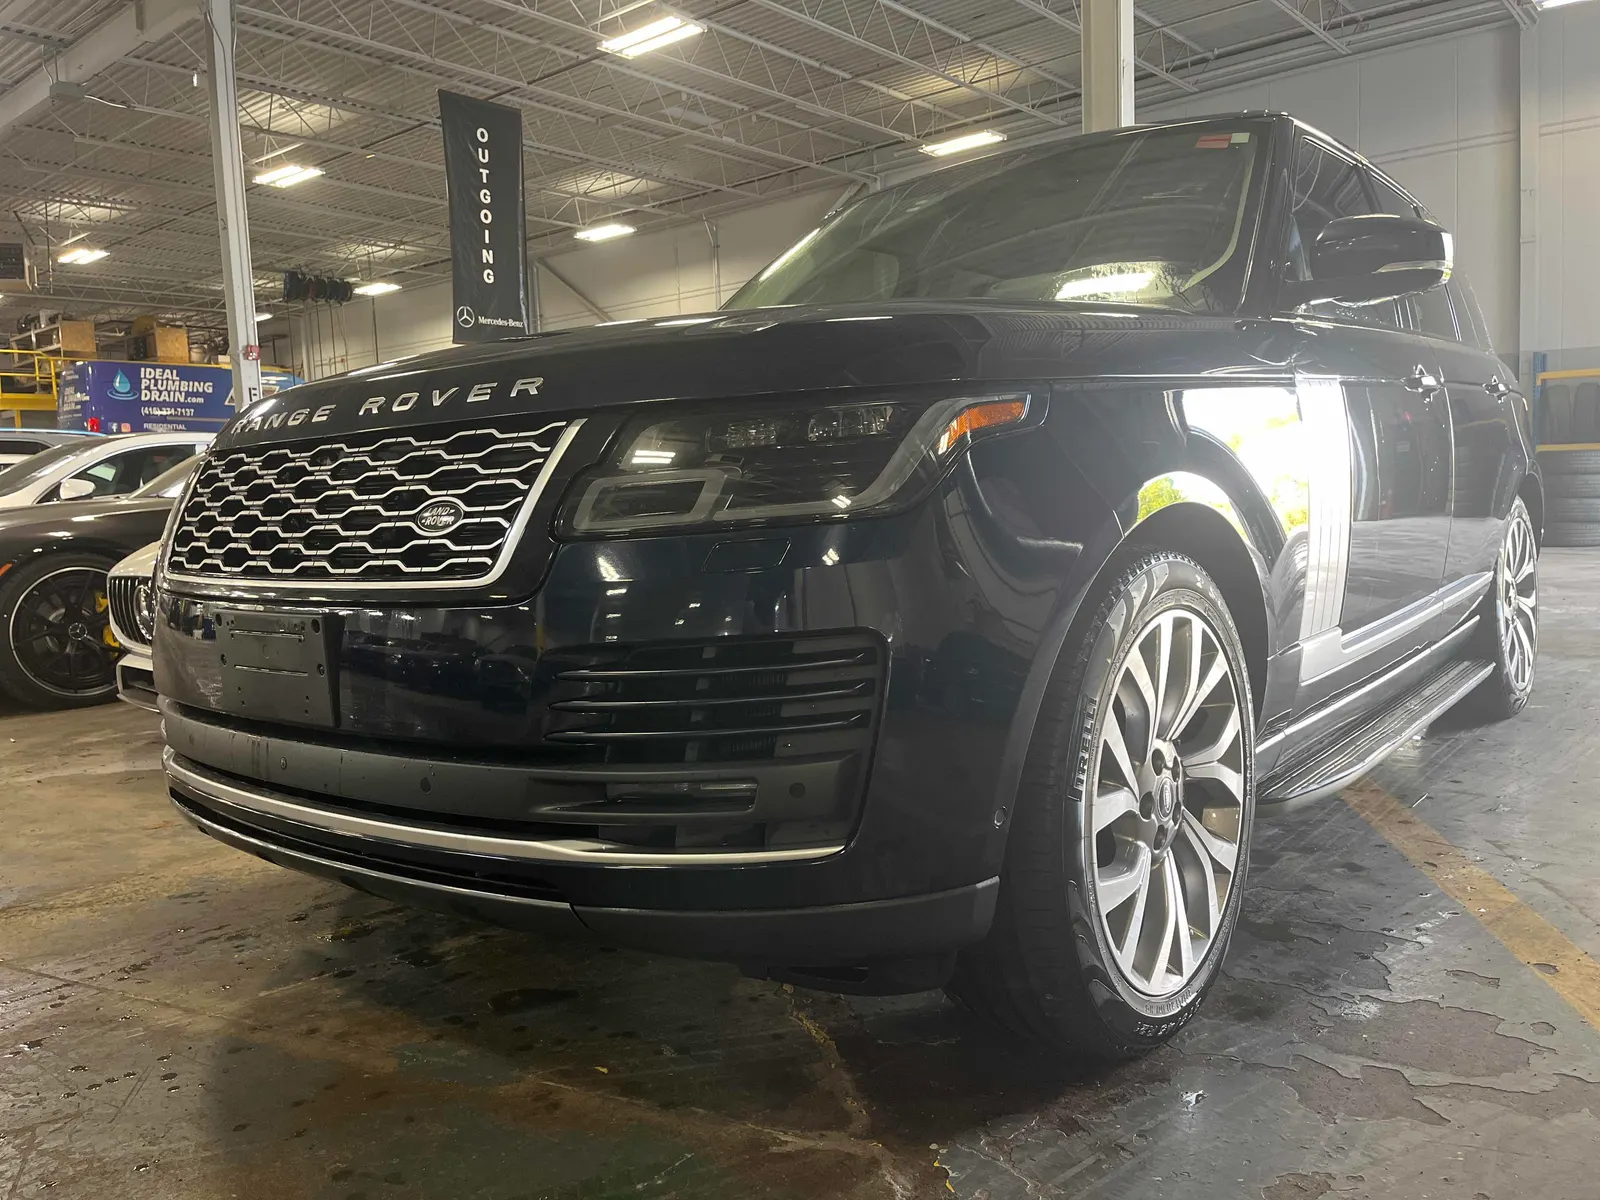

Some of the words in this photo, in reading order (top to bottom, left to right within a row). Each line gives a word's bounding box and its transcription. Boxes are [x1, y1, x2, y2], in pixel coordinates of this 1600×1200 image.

[476, 127, 494, 284] OUTGOING
[478, 315, 524, 328] Mercedes-Benz
[140, 367, 180, 380] IDEAL
[141, 378, 213, 394] PLUMBING
[141, 390, 204, 403] DRAIN.com
[231, 404, 337, 435] RANGE
[358, 377, 545, 416] ROVER
[143, 422, 187, 431] RESIDENTIAL
[426, 506, 451, 516] LAND
[424, 515, 455, 527] ROVER
